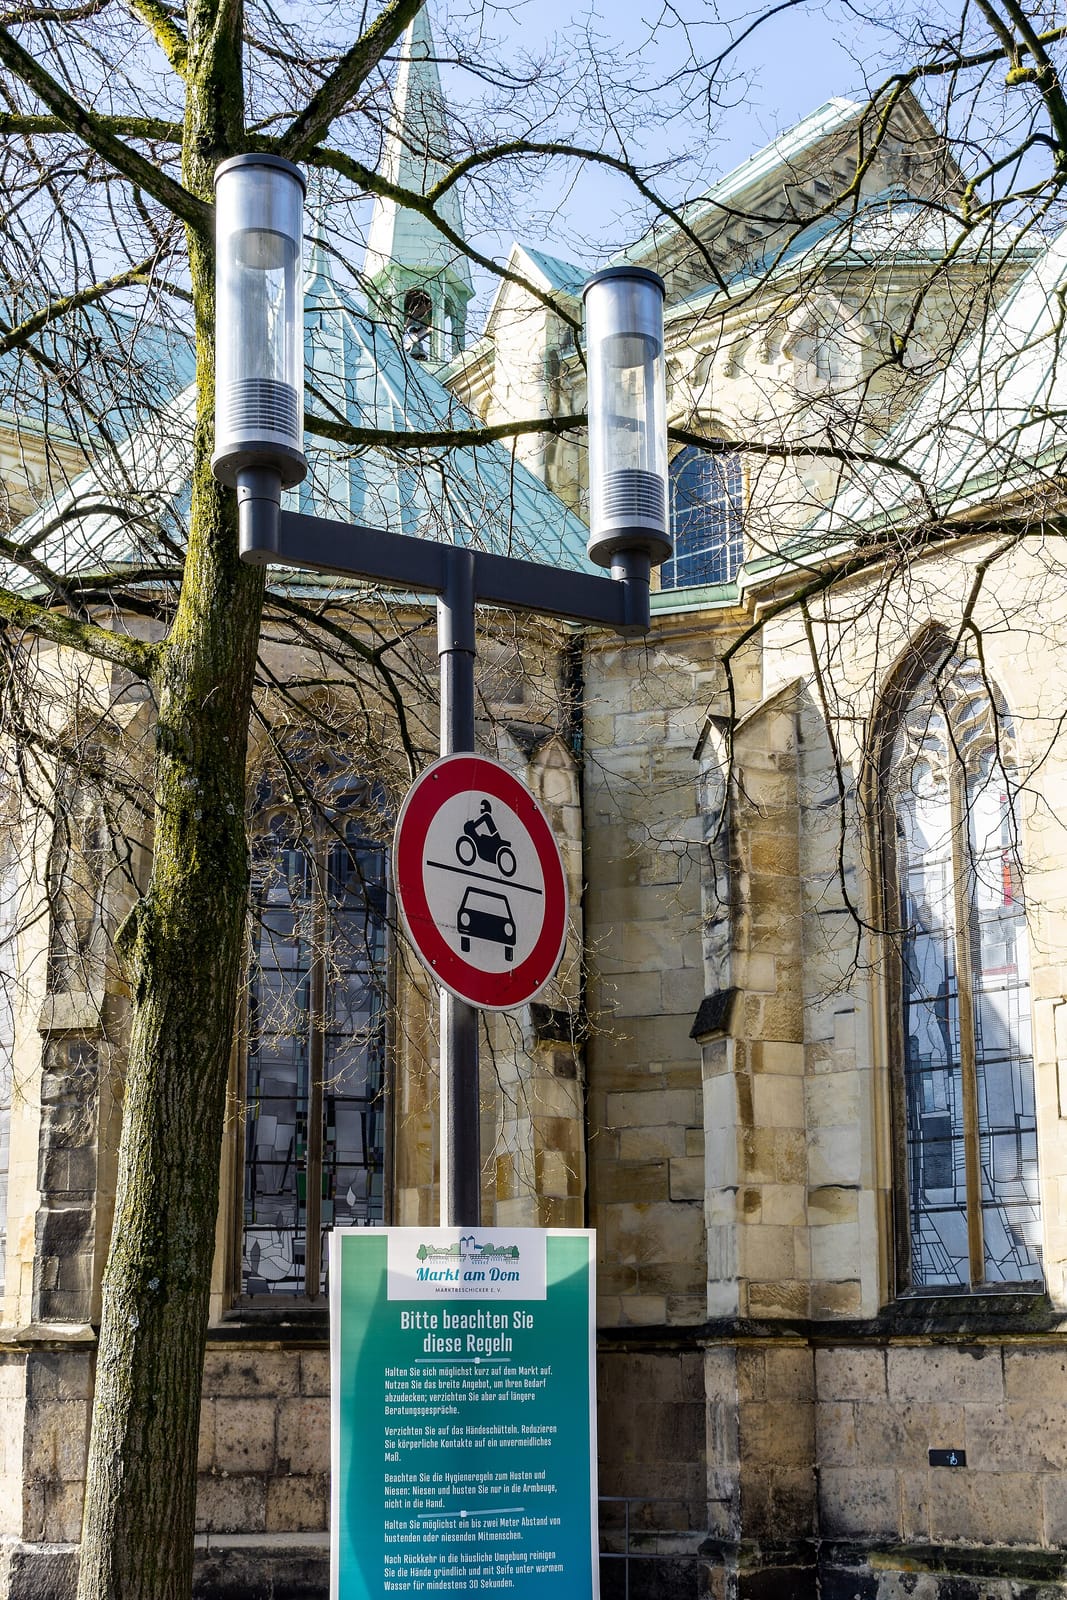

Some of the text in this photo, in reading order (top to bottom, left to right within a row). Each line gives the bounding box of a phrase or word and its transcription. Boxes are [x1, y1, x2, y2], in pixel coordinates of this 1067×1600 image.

[416, 1267, 520, 1282] Markt am Dom
[400, 1309, 534, 1329] Bitte beachten Sie
[423, 1332, 513, 1356] diese Regeln
[385, 1366, 553, 1378] Halten Sie sich möglichst kurz auf dem Markt auf.
[385, 1378, 546, 1390] Nutzen Sie das breite Angebot, um Ihren Bedarf
[385, 1391, 536, 1403] abzudecken; verzichten Sie aber auf längere
[385, 1405, 460, 1416] Beratungsgespräche.
[385, 1424, 557, 1436] Verzichten Sie auf das Händeschütteln. Reduzieren
[385, 1437, 552, 1450] Sie körperliche Kontakte auf ein unvermeidliches
[385, 1452, 401, 1462] Maß.
[384, 1473, 417, 1483] Beachten
[419, 1472, 430, 1483] Sie
[432, 1472, 443, 1482] die
[445, 1471, 493, 1484] Hygieneregeln
[495, 1472, 508, 1481] zum
[534, 1470, 546, 1480] und
[384, 1483, 558, 1496] Niesen: Niesen und husten Sie nur in die Armbeuge,
[384, 1498, 445, 1509] nicht in die Hand.
[384, 1516, 561, 1531] Halten Sie möglichst ein bis zwei Meter Abstand von
[384, 1531, 524, 1543] hustenden oder niesenden Mitmenschen.
[384, 1551, 556, 1564] Nach Rückkehr in die häusliche Umgebung reinigen
[384, 1564, 564, 1578] Sie die Hände gründlich und mit Seife unter warmem
[384, 1579, 515, 1591] Wasser für mindestens 30 Sekunden.
